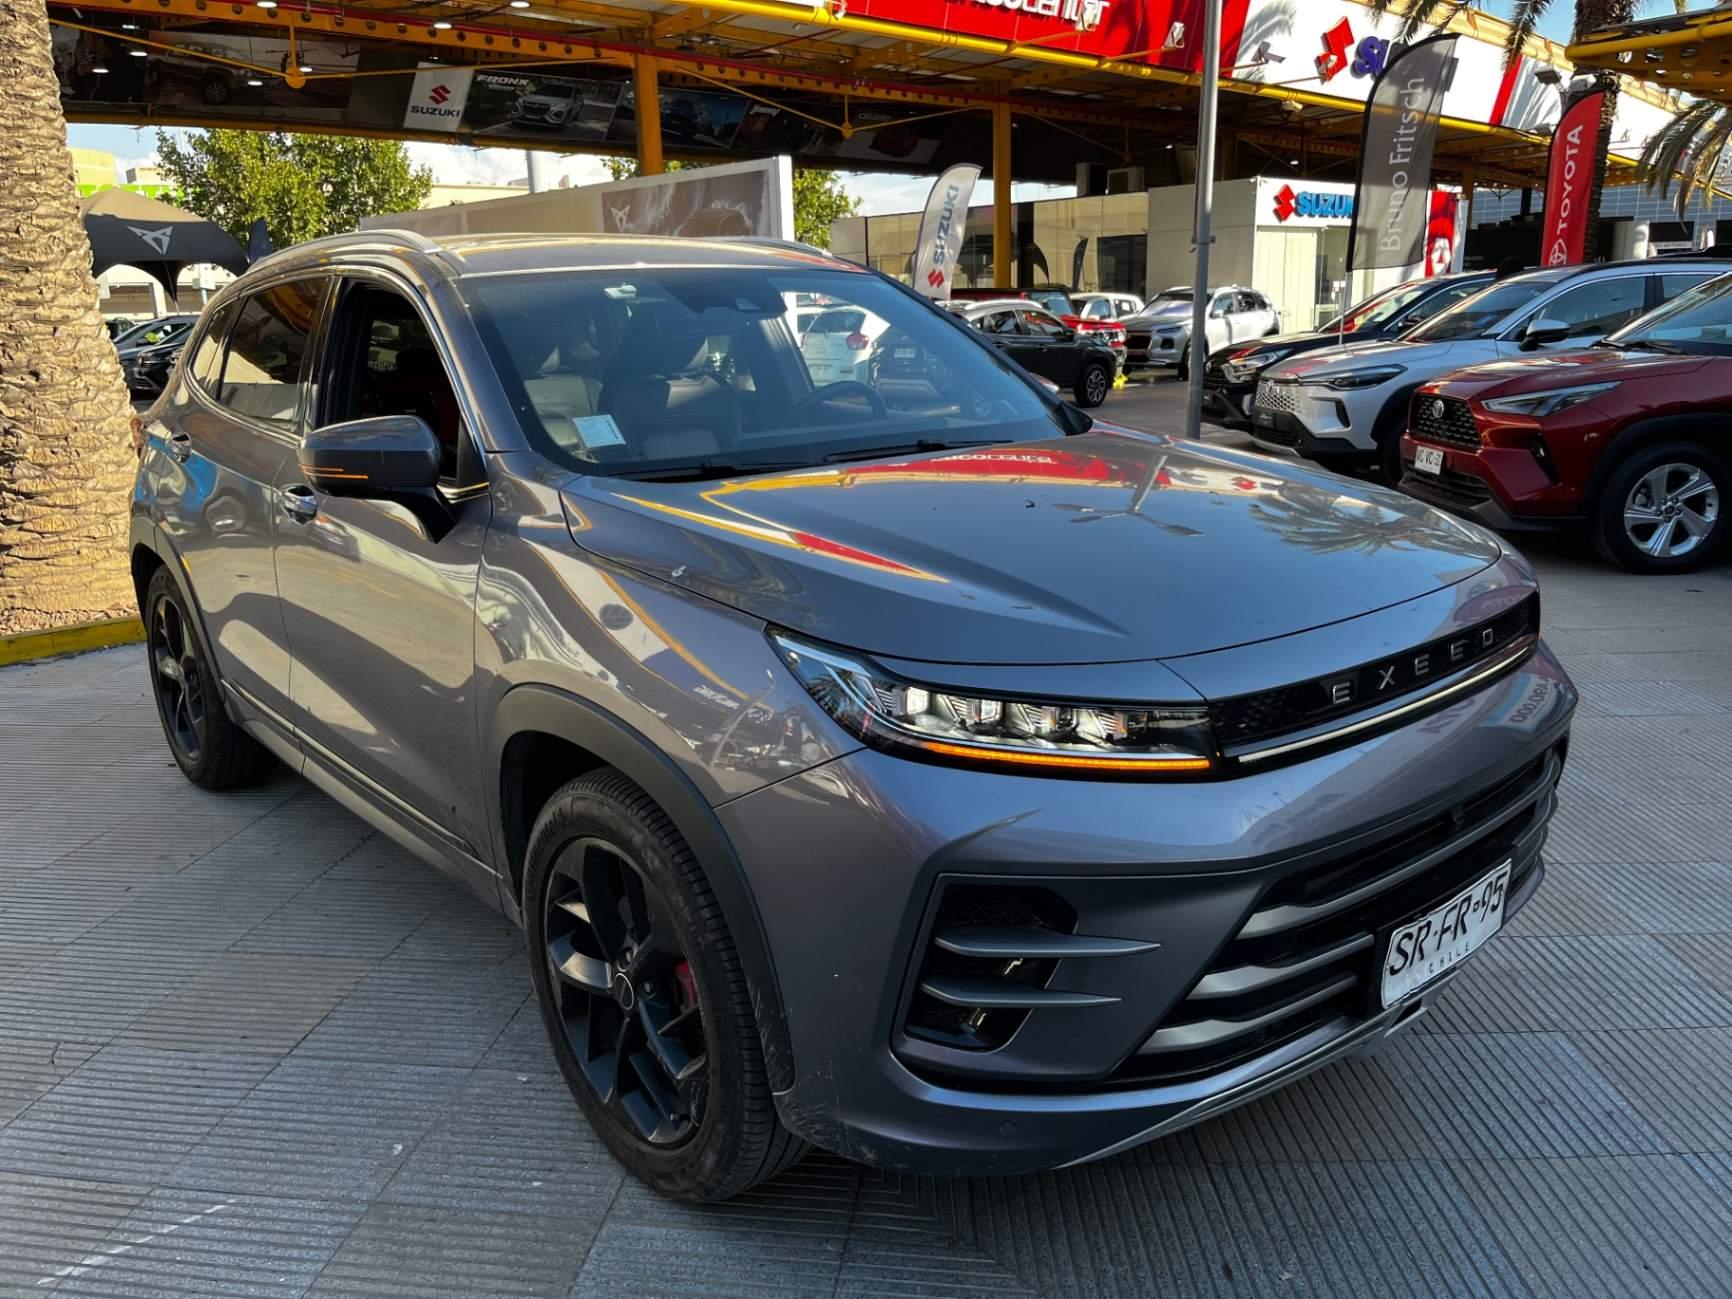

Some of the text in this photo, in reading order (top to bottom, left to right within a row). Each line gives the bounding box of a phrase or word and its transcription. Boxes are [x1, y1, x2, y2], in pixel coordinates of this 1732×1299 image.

[410, 105, 461, 118] SUZUKI
[476, 75, 530, 86] FRONX
[1381, 77, 1425, 251] Bruno Fritsch
[1556, 124, 1584, 235] TOYOTA
[933, 184, 960, 265] SUZUKI
[1332, 628, 1494, 705] EXEED
[1429, 940, 1470, 974] CHILE
